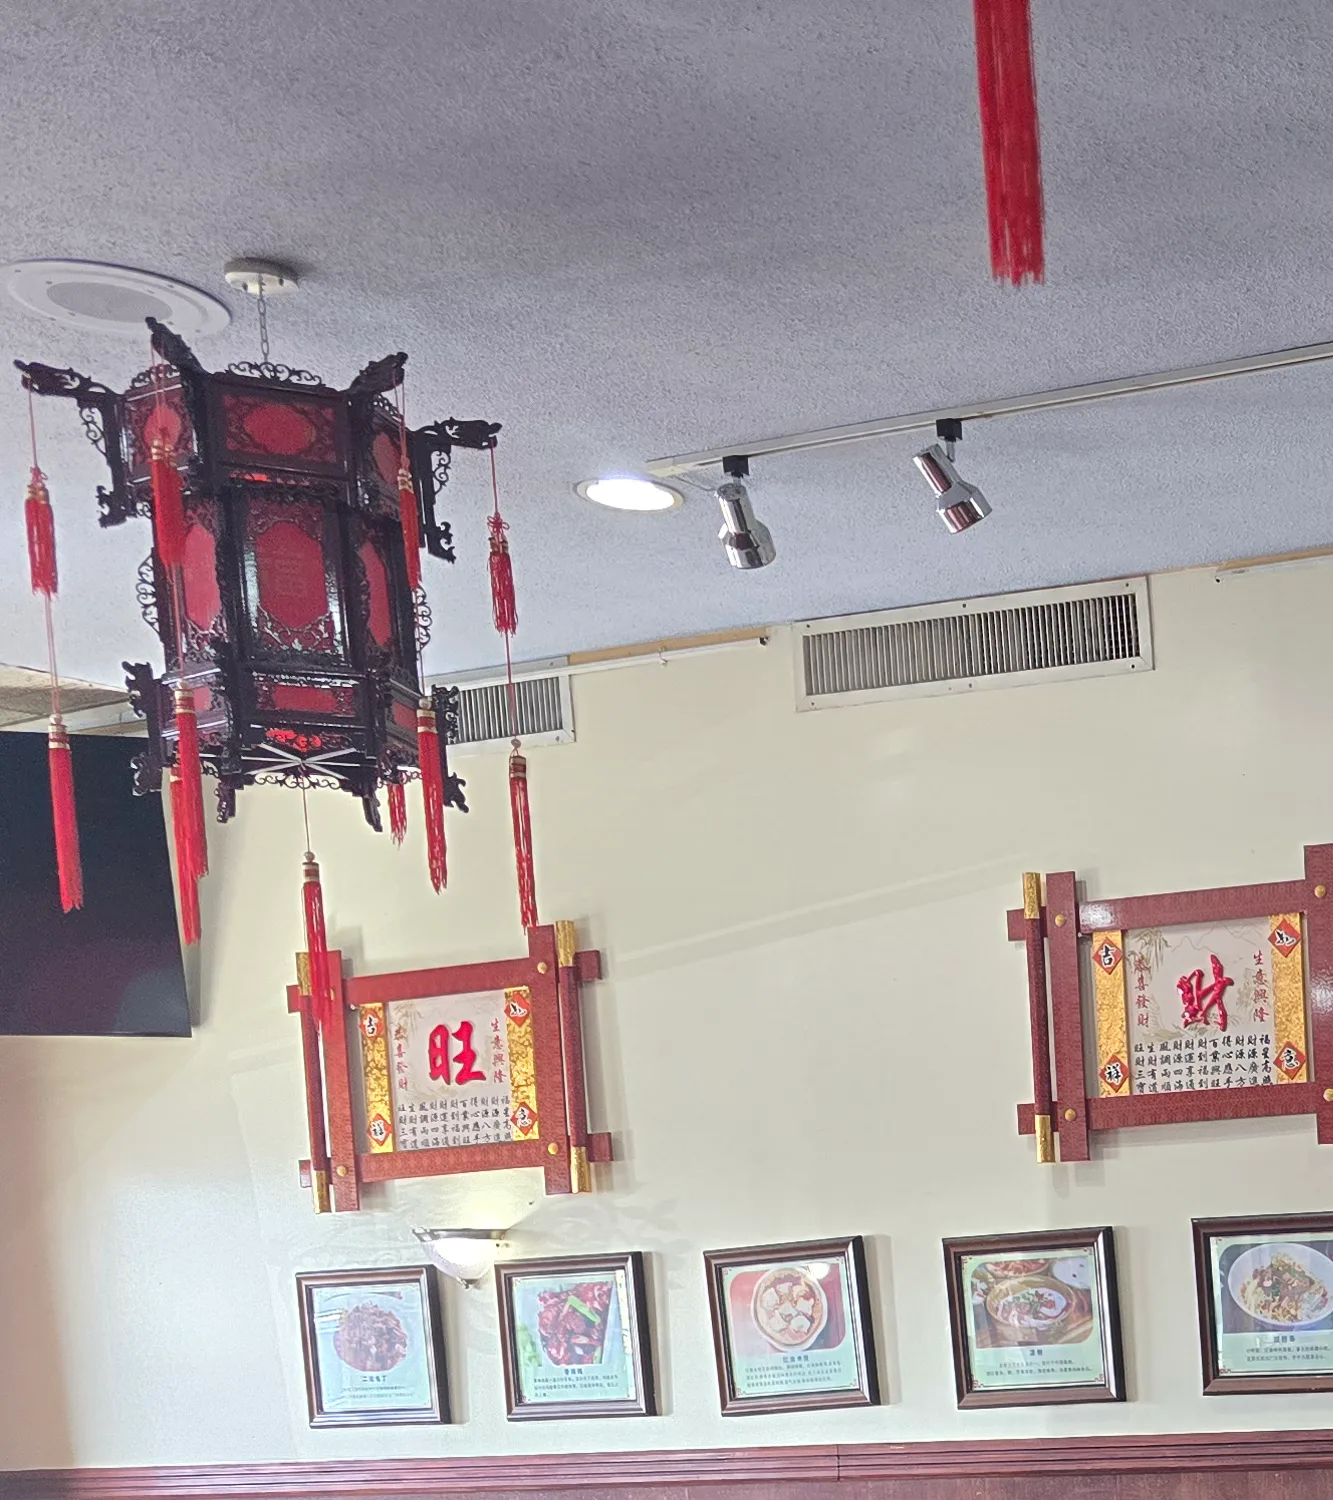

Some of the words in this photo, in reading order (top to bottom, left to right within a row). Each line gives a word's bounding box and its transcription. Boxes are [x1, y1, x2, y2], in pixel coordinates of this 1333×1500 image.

[1100, 945, 1115, 966] 吉
[1176, 953, 1235, 1032] 財
[1252, 950, 1270, 1023] 生意興隆
[365, 1016, 377, 1035] 吉
[428, 1021, 486, 1086] 旺
[1281, 1050, 1298, 1069] 意
[1104, 1064, 1122, 1083] 祥
[371, 1121, 384, 1138] 祥
